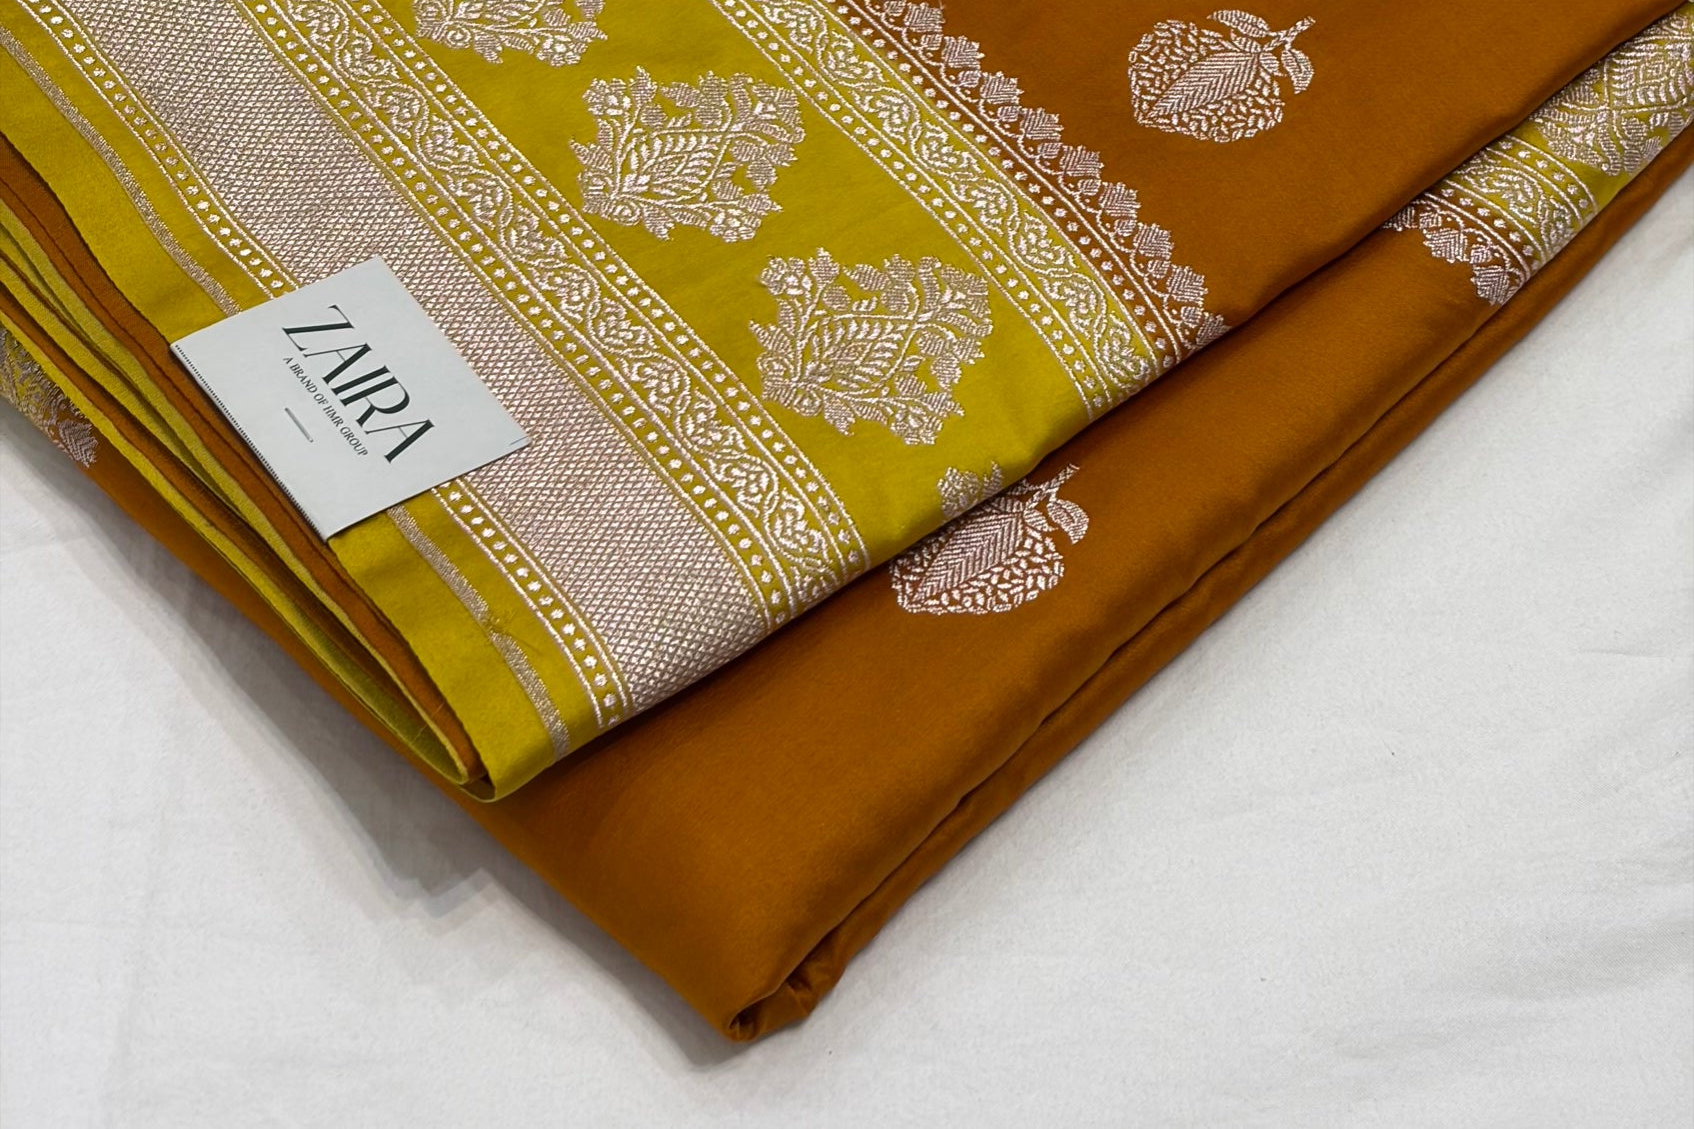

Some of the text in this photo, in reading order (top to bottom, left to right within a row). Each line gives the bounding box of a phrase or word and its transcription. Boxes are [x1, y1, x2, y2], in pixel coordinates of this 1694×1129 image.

[282, 304, 435, 464] ZAIRA
[289, 363, 318, 394] BRAND
[313, 393, 329, 405] OF
[322, 405, 345, 428] HMR
[340, 426, 369, 456] GROUP
